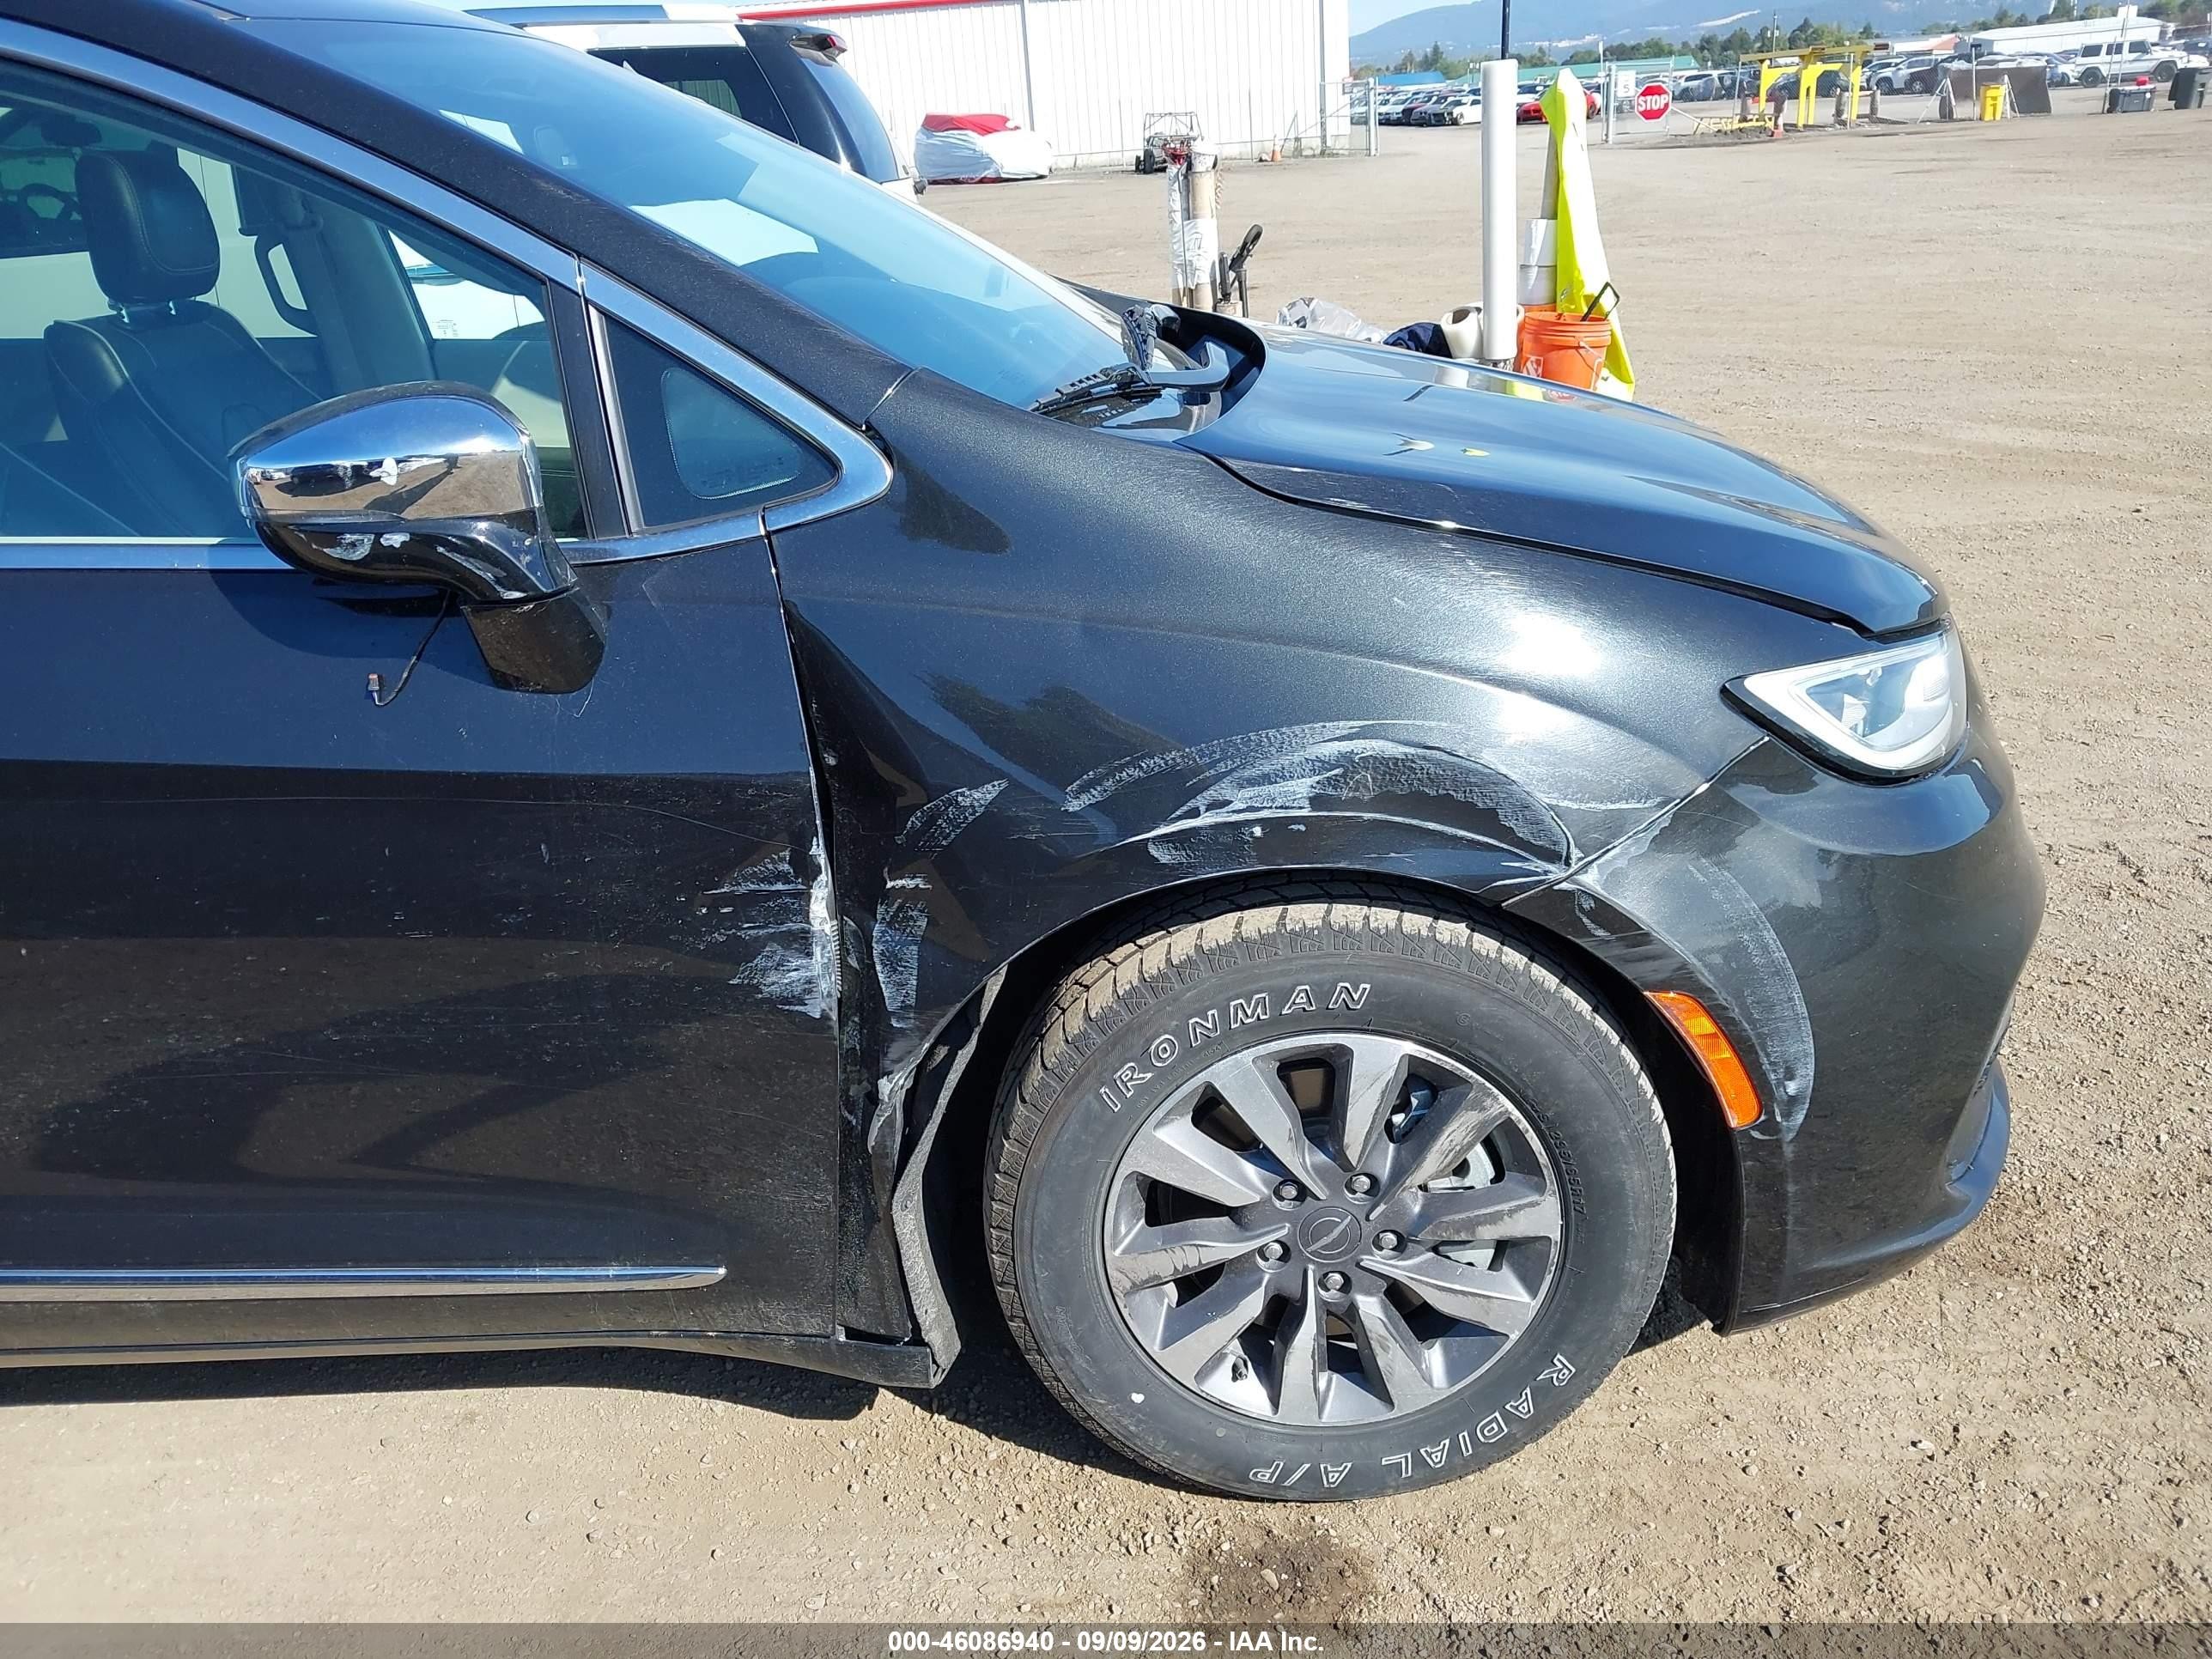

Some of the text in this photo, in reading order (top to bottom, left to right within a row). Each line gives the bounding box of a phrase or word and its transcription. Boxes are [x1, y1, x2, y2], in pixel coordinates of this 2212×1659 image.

[1638, 94, 1668, 112] STOP
[1101, 982, 1370, 1112] IRONMAN
[1249, 1352, 1574, 1488] RADIAL A/P
